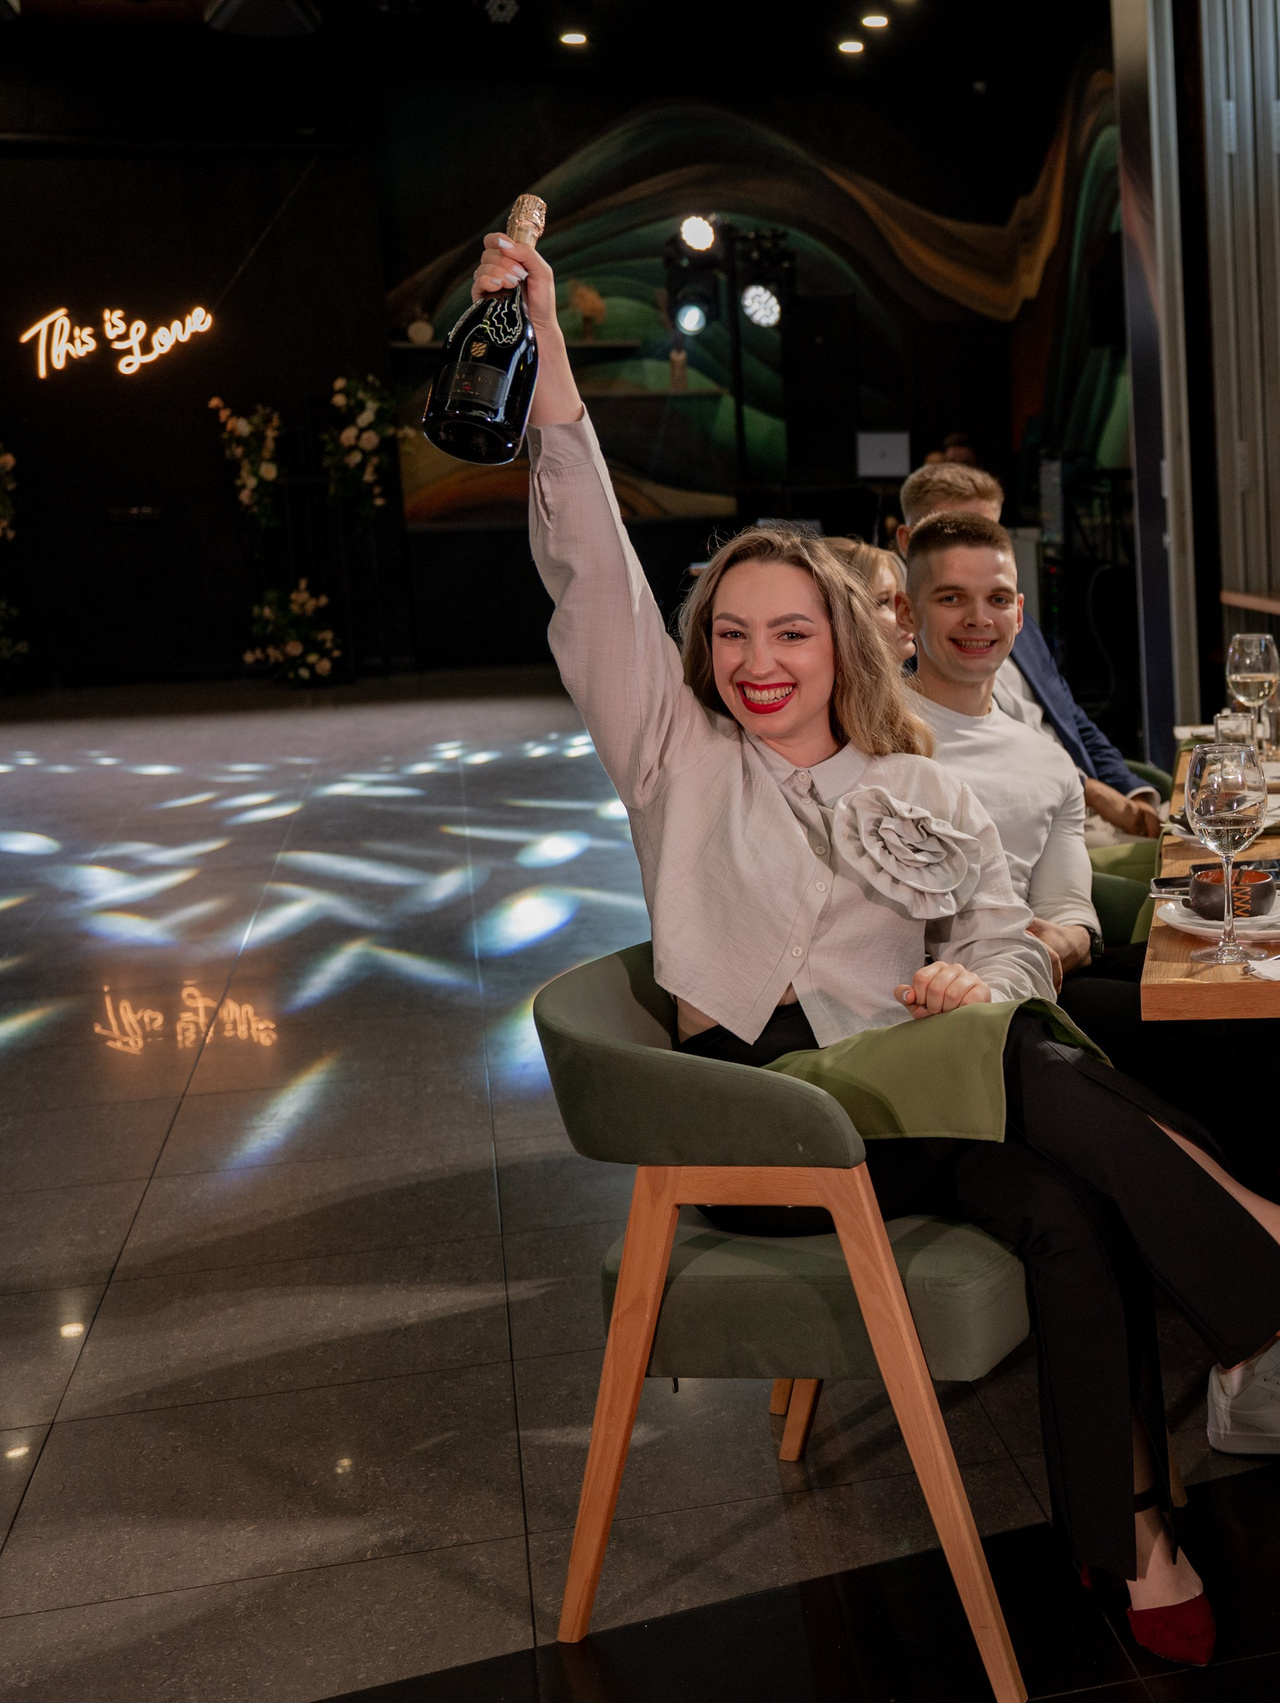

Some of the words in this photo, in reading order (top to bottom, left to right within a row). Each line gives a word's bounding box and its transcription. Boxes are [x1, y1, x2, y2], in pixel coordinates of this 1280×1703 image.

[19, 307, 97, 380] This
[103, 308, 127, 340] is
[111, 306, 213, 376] Love
